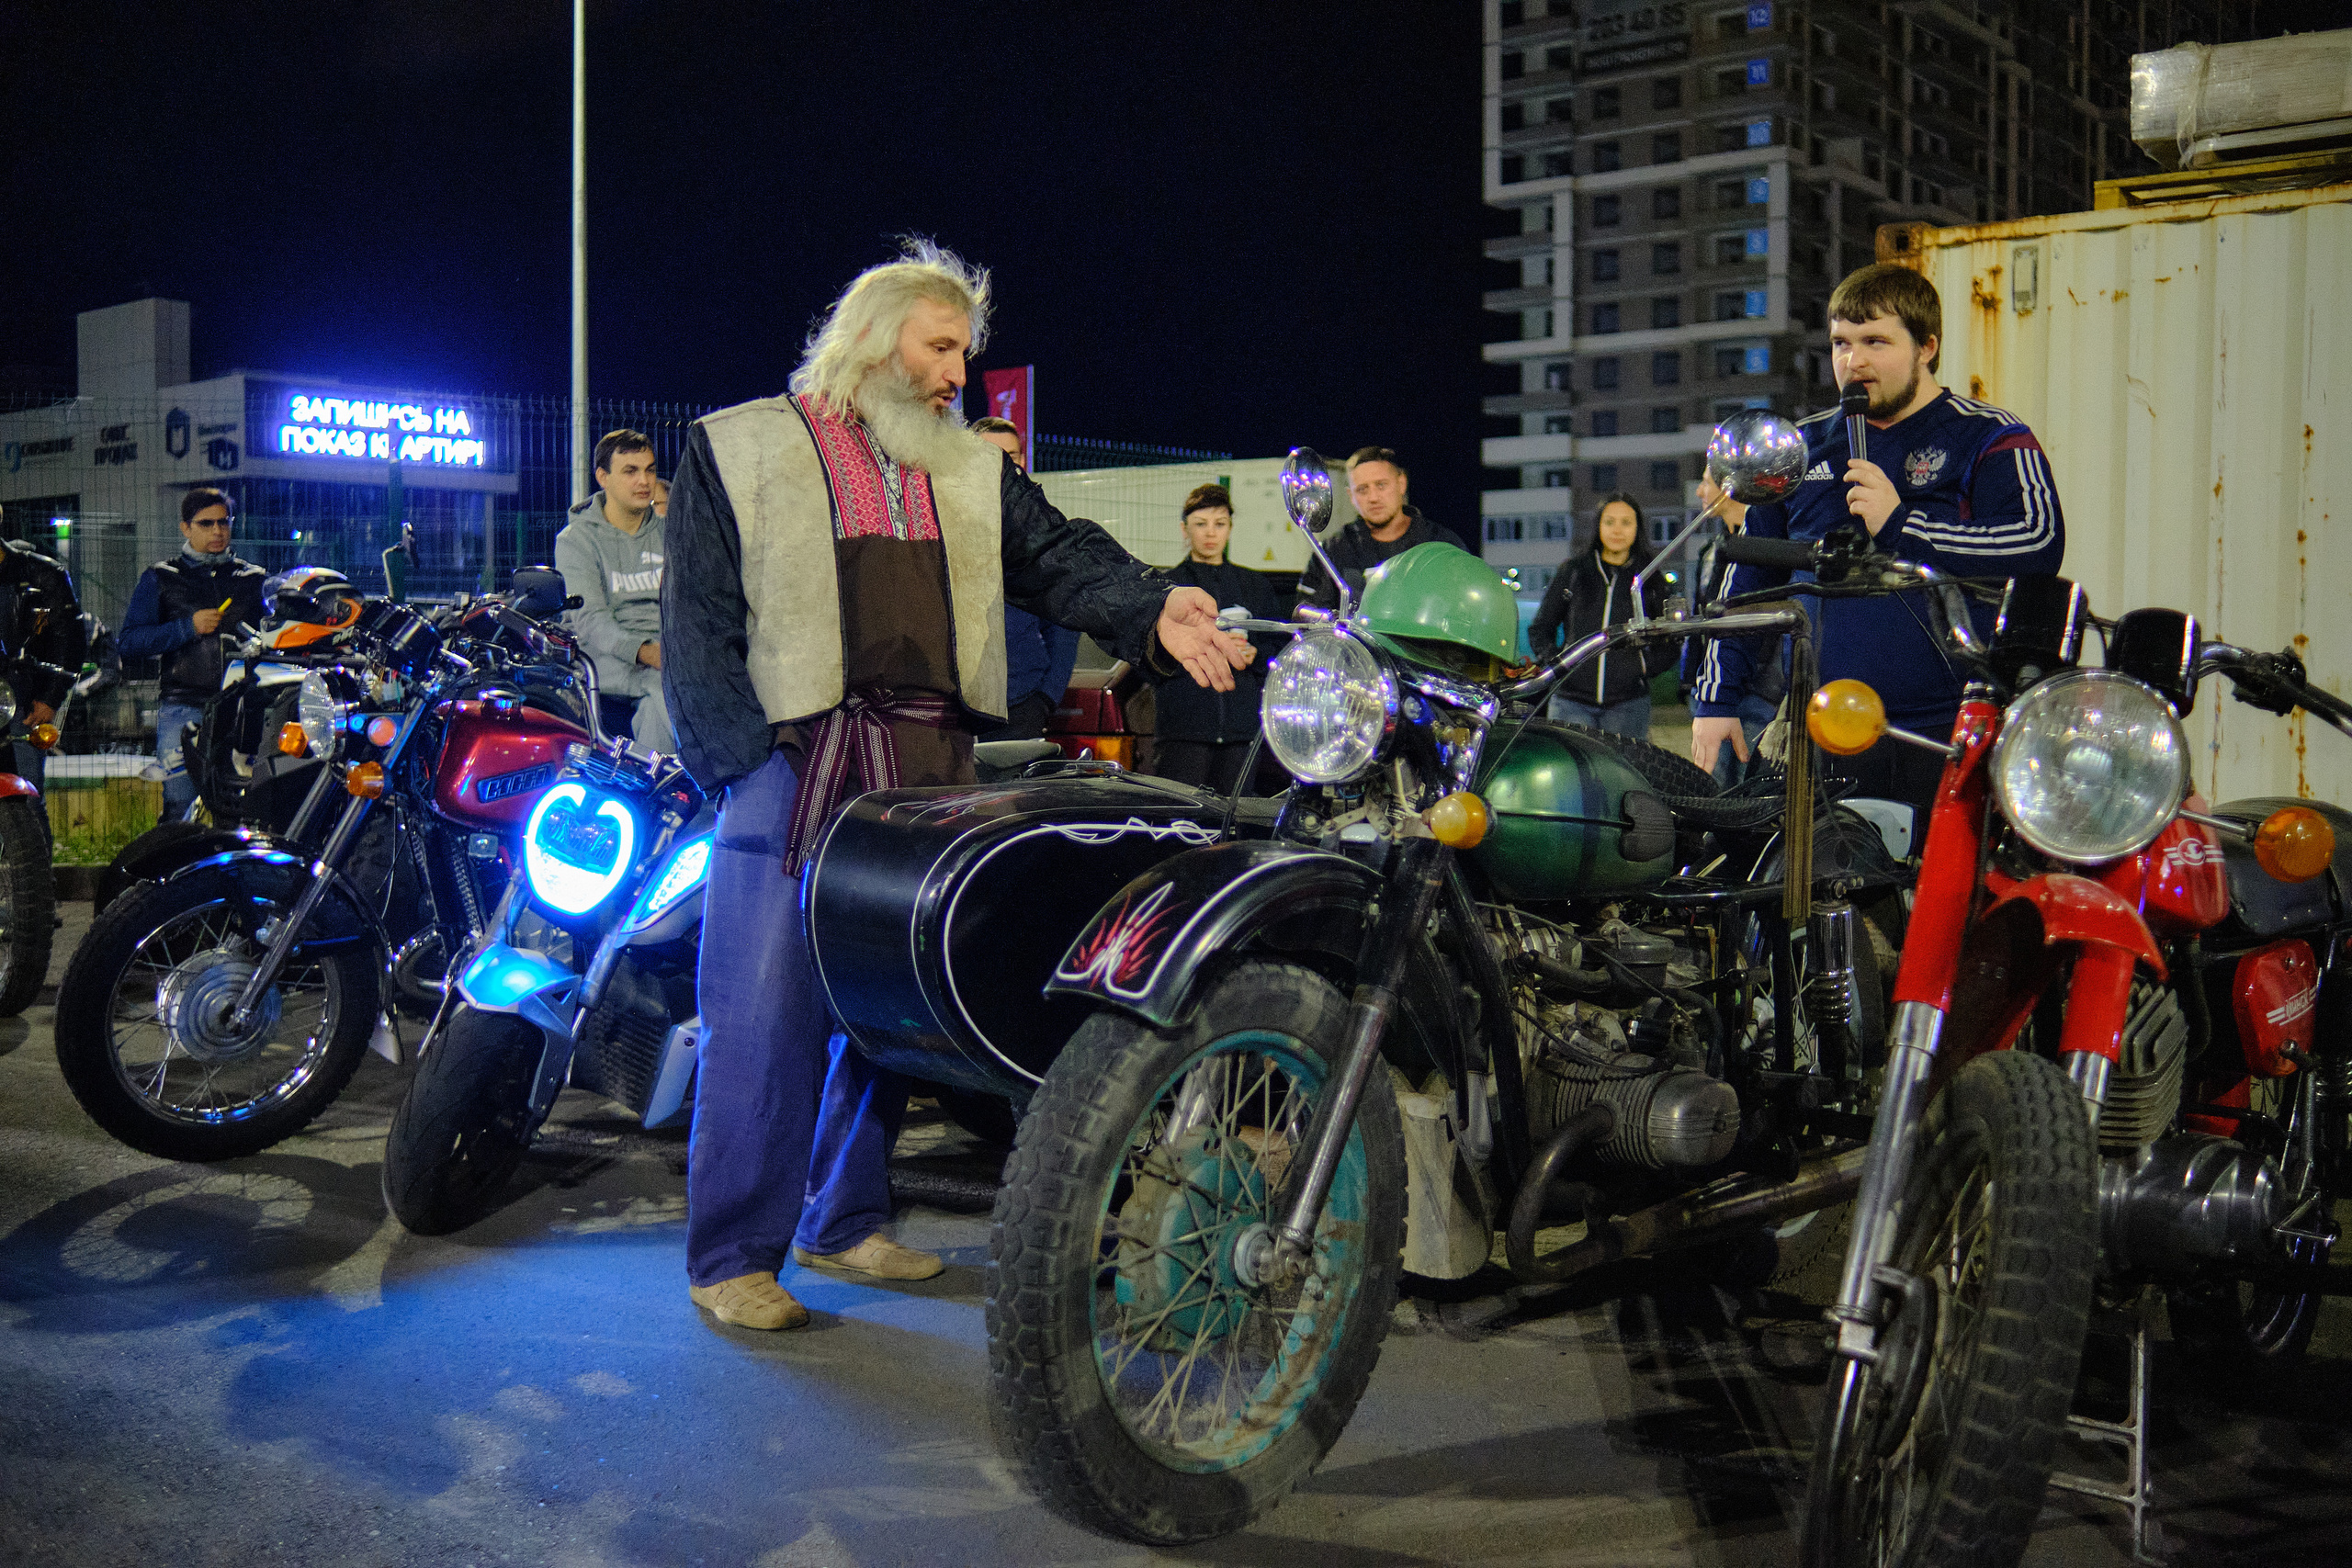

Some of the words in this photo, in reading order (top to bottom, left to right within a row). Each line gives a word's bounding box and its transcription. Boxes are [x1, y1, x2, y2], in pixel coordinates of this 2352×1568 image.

[433, 407, 471, 435] НА
[279, 424, 367, 457] ПОКАЗ
[368, 432, 485, 467] КАРТИР!
[1804, 473, 1835, 481] adidas
